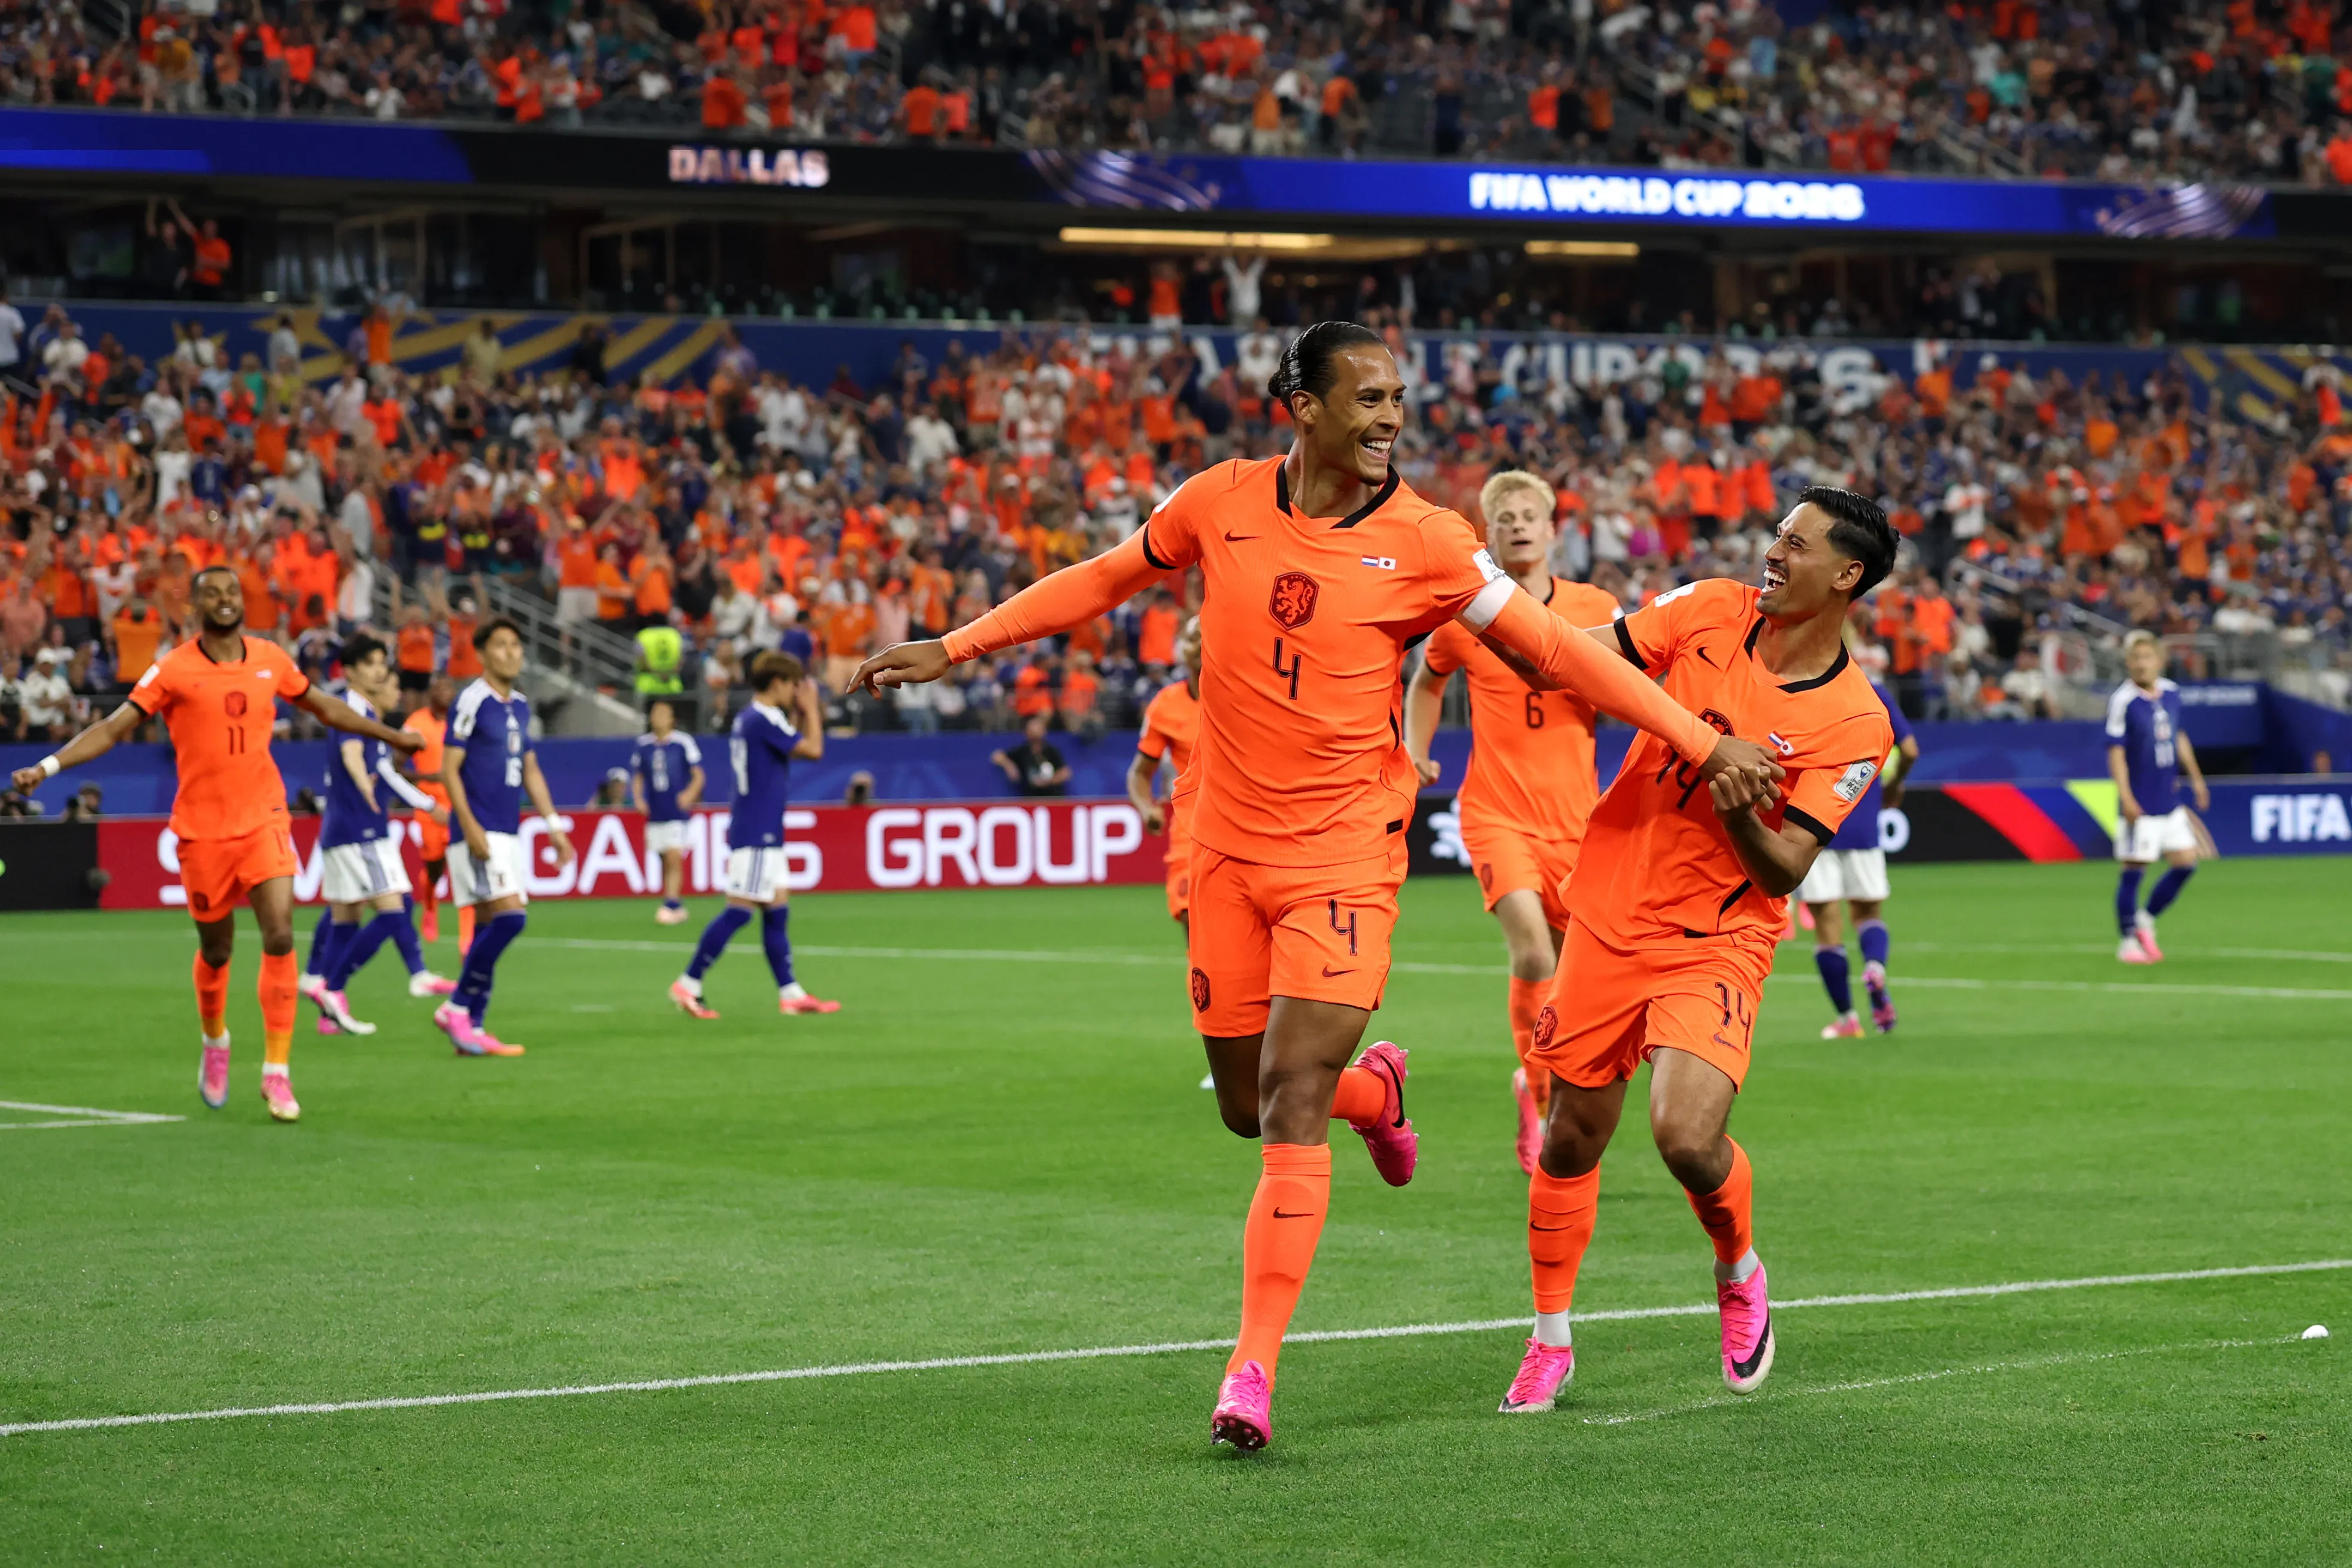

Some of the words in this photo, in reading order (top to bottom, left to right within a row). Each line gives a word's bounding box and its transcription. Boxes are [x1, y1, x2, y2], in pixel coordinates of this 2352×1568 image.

[668, 145, 830, 187] DALLAS
[1469, 172, 1549, 211] FIFA
[1546, 174, 1673, 215] WORLD
[1675, 178, 1740, 217] CUP
[1272, 637, 1301, 700] 4
[1525, 691, 1545, 729] 6
[228, 725, 245, 756] 11
[1655, 744, 1703, 811] 14
[2250, 793, 2351, 843] FIFA
[865, 804, 1143, 888] GROUP
[1328, 898, 1357, 956] 4
[1715, 982, 1751, 1051] 14
